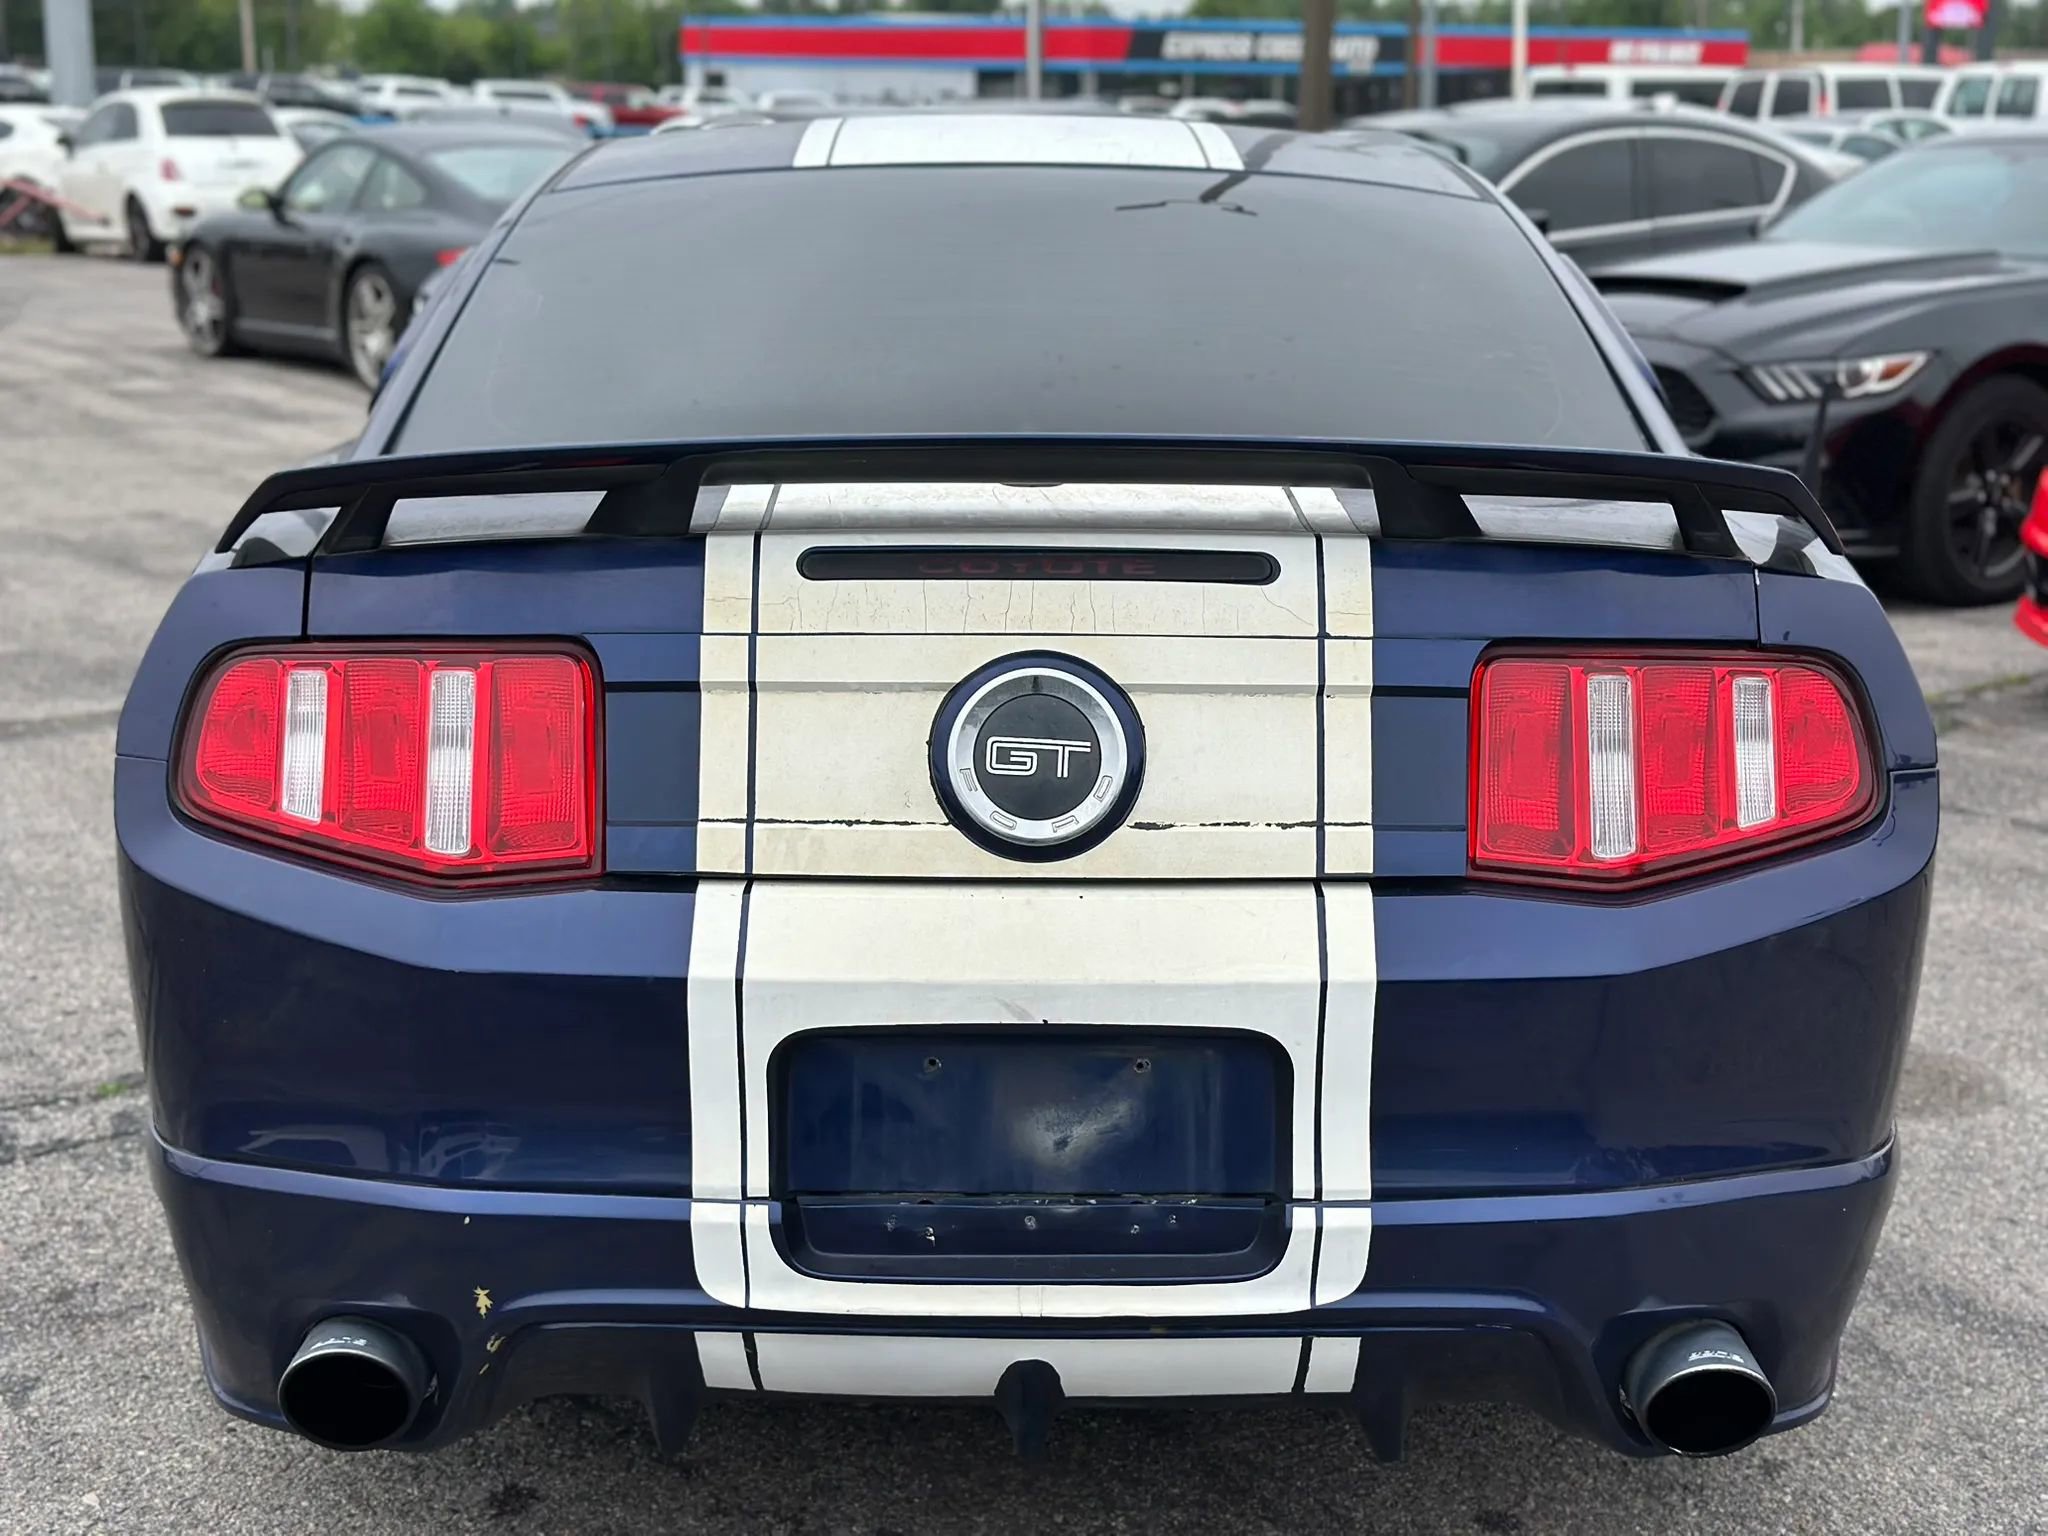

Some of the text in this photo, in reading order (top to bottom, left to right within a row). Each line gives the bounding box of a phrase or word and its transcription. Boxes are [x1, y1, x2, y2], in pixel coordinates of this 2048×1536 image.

[918, 559, 1157, 575] COYOTE
[985, 736, 1092, 778] GT
[959, 767, 1114, 834] FORD
